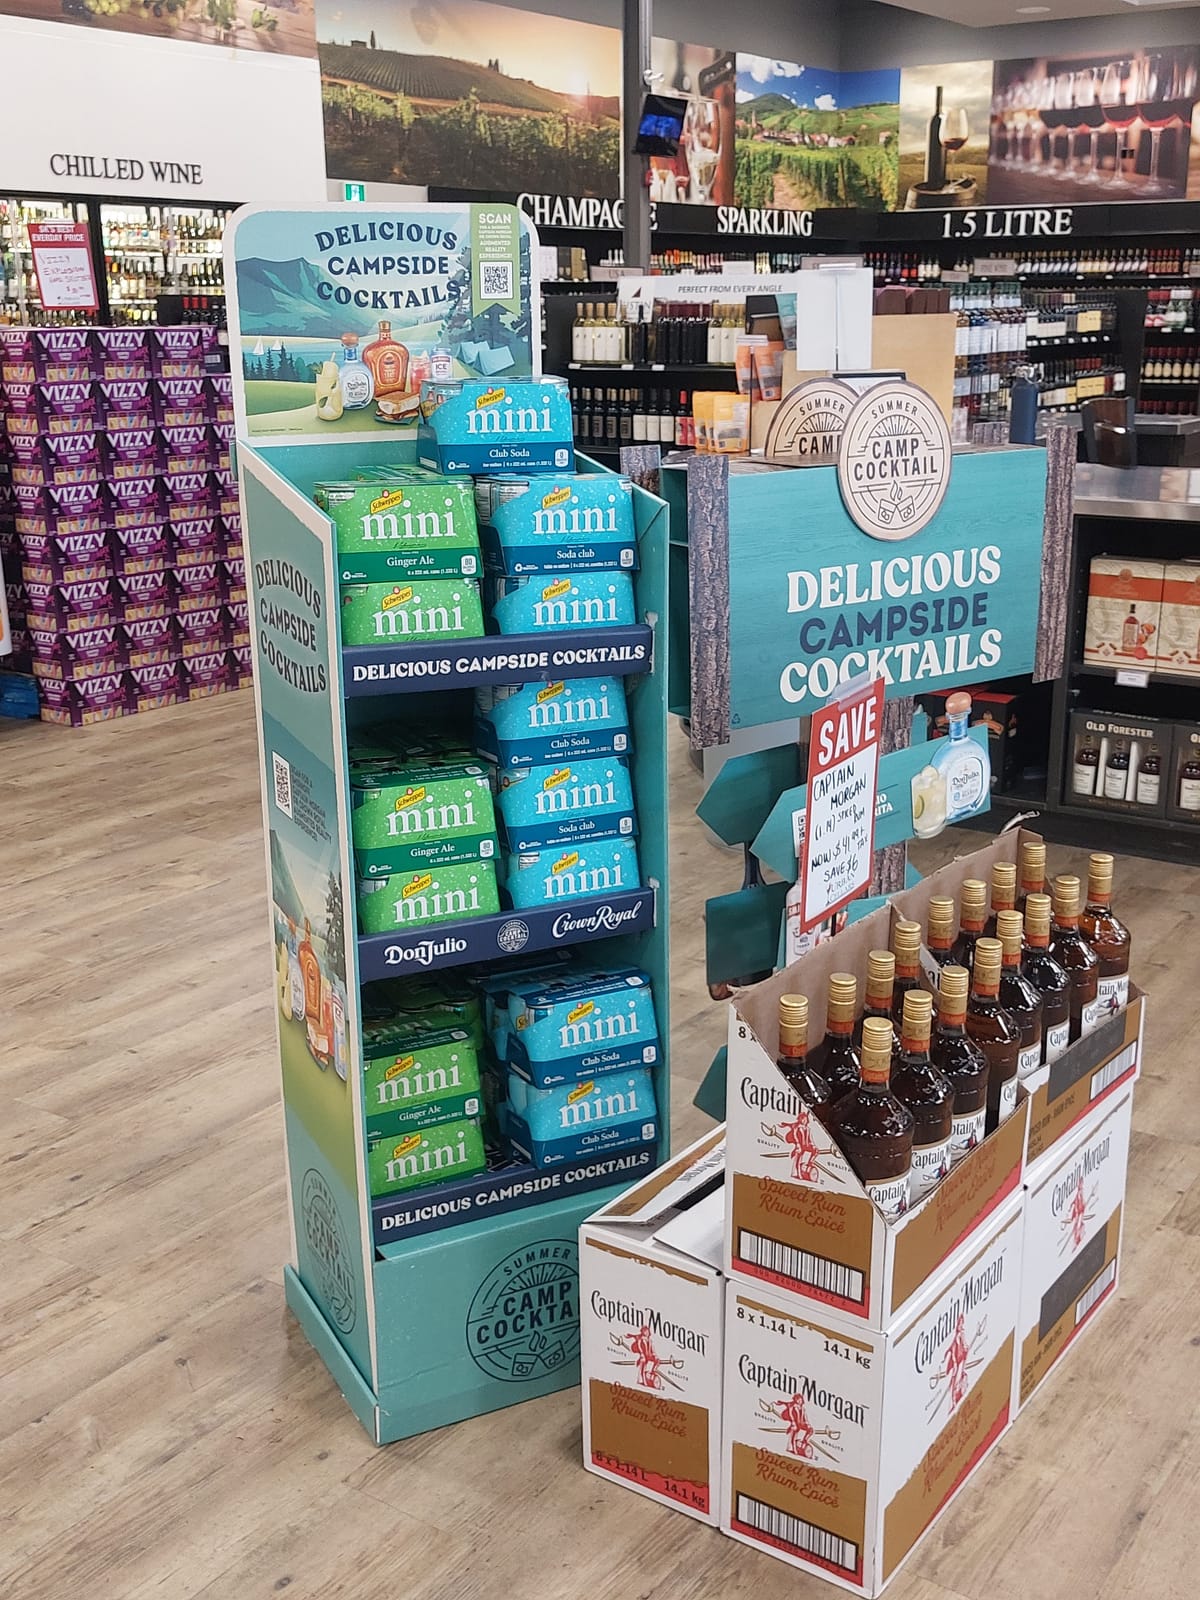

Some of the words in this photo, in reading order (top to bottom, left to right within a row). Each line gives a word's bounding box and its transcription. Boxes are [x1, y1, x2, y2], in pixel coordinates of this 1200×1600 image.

[50, 153, 144, 181] CHILLED
[150, 160, 203, 185] WINE
[479, 213, 512, 224] SCAN
[717, 205, 813, 236] SPARKLING
[941, 211, 976, 238] 1.5
[984, 208, 1073, 237] LITRE
[315, 221, 458, 252] DELICIOUS
[327, 256, 449, 275] CAMPSIDE
[608, 269, 625, 278] USA
[316, 280, 462, 309] COCKTAILS
[678, 284, 707, 294] PERFECT
[709, 284, 731, 293] FROM
[733, 283, 756, 293] EVERY
[758, 283, 783, 293] ANGLE
[0, 332, 28, 343] VIZZY
[38, 332, 88, 348] VIZZY
[97, 332, 145, 347] VIZZY
[154, 331, 200, 346] VIZZY
[3, 384, 31, 395] VIZZY
[40, 384, 92, 401] VIZZY
[100, 382, 149, 398] VIZZY
[158, 380, 203, 395] VIZZY
[466, 396, 553, 433] mini
[800, 397, 845, 416] SUMMER
[871, 400, 918, 419] SUMMER
[9, 435, 36, 447] VIZZY
[45, 434, 96, 452] VIZZY
[106, 431, 154, 448] VIZZY
[161, 426, 206, 443] VIZZY
[489, 449, 508, 458] Club
[510, 448, 530, 457] Soda
[872, 438, 919, 459] CAMP
[854, 456, 938, 481] COCKTAIL
[12, 486, 39, 497] VIZZY
[108, 479, 155, 496] VIZZY
[163, 474, 207, 490] VIZZY
[49, 484, 99, 503] VIZZY
[372, 494, 402, 510] Schweppes
[360, 498, 457, 540] mini
[532, 494, 618, 534] mini
[117, 526, 164, 544] VIZZY
[170, 519, 214, 536] VIZZY
[19, 534, 47, 547] VIZZY
[56, 532, 106, 552] VIZZY
[387, 556, 417, 568] Ginger
[419, 556, 434, 565] Ale
[556, 549, 577, 559] Soda
[578, 549, 595, 558] club
[118, 572, 165, 591] VIZZY
[173, 564, 216, 583] VIZZY
[786, 545, 1001, 614] DELICIOUS
[23, 583, 51, 595] VIZZY
[59, 580, 109, 600] VIZZY
[256, 559, 321, 619] DELICIOUS
[372, 593, 465, 636] mini
[532, 585, 618, 626] mini
[123, 618, 169, 637] VIZZY
[176, 609, 220, 628] VIZZY
[260, 598, 316, 652] CAMPSIDE
[800, 592, 988, 654] CAMPSIDE
[30, 630, 57, 643] VIZZY
[65, 627, 115, 649] VIZZY
[183, 652, 226, 672] VIZZY
[261, 630, 326, 692] COCKTAILS
[353, 659, 451, 681] DELICIOUS
[455, 652, 548, 673] CAMPSIDE
[552, 645, 645, 665] COCKTAILS
[779, 629, 1002, 703] COCKTAILS
[131, 662, 176, 683] VIZZY
[39, 678, 66, 690] VIZZY
[74, 673, 123, 696] VIZZY
[528, 684, 611, 727] mini
[818, 696, 878, 766] SAVE
[1086, 720, 1106, 732] OLD
[1108, 723, 1154, 738] FORESTER
[551, 740, 569, 749] Club
[571, 737, 590, 746] Soda
[535, 770, 616, 814] mini
[813, 761, 854, 801] CAPTAIN
[830, 772, 866, 810] MORGAN
[386, 790, 477, 836] mini
[559, 824, 577, 833] Soda
[579, 822, 595, 831] club
[410, 847, 438, 858] Ginger
[441, 844, 455, 852] Ale
[811, 848, 831, 873] NOW
[543, 853, 624, 899] mini
[824, 860, 845, 882] SAVE
[393, 875, 480, 923] mini
[559, 1000, 640, 1048] mini
[738, 1026, 746, 1039] 8
[582, 1055, 600, 1066] Club
[602, 1052, 620, 1061] Soda
[376, 1054, 462, 1104] mini
[559, 1080, 641, 1128] mini
[741, 1077, 801, 1116] Captain
[399, 1108, 427, 1121] Ginger
[428, 1105, 442, 1115] Ale
[581, 1134, 600, 1145] Club
[601, 1130, 620, 1140] Soda
[385, 1131, 468, 1182] mini
[911, 1148, 944, 1169] Captain
[1051, 1162, 1081, 1217] Captain
[1080, 1131, 1112, 1180] Morgan
[381, 1197, 472, 1230] DELICIOUS
[475, 1174, 561, 1206] CAMPSIDE
[564, 1152, 650, 1183] COCKTAILS
[758, 1175, 808, 1202] Spiced
[811, 1193, 846, 1217] Rum
[760, 1193, 803, 1219] Rhum
[504, 1247, 571, 1276] SUMMER
[503, 1281, 572, 1317] CAMP
[477, 1300, 574, 1344] COCKTA
[914, 1298, 961, 1374] Captain
[960, 1248, 1007, 1314] Morgan
[591, 1290, 644, 1328] Captain
[645, 1308, 709, 1358] Morgan
[736, 1306, 745, 1319] 8
[748, 1313, 755, 1324] x
[759, 1315, 785, 1335] 1.14
[789, 1327, 797, 1340] L
[824, 1340, 851, 1361] 14.1
[855, 1351, 871, 1370] kg
[610, 1381, 652, 1409] Spiced
[655, 1398, 687, 1422] Rum
[738, 1354, 798, 1395] Captain
[798, 1375, 869, 1428] Morgan
[611, 1397, 649, 1423] Rhum
[596, 1450, 603, 1461] 8
[615, 1459, 638, 1477] 1.14
[641, 1471, 648, 1482] L
[755, 1447, 804, 1476] Spiced
[805, 1467, 840, 1493] Rum
[756, 1463, 799, 1493] Rhum
[664, 1480, 688, 1500] 14.1
[691, 1491, 705, 1508] kg
